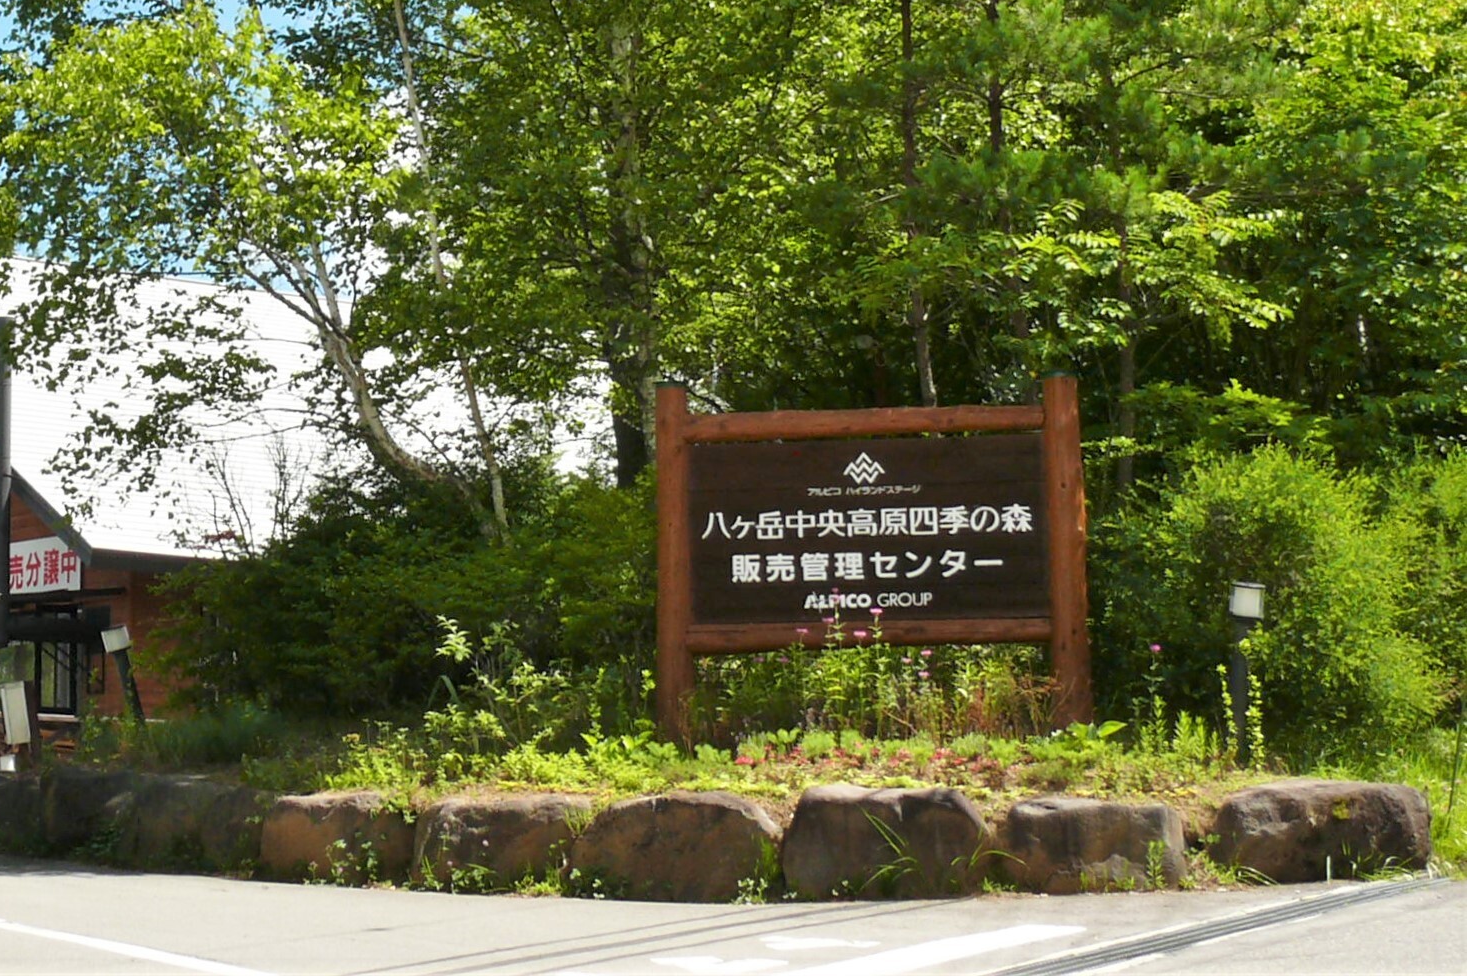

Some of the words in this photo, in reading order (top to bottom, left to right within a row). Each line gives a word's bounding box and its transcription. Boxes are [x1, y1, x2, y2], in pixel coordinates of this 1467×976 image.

[731, 549, 1004, 583] 販売管理センター
[804, 592, 872, 610] ALPICO
[877, 591, 933, 607] GROUP
